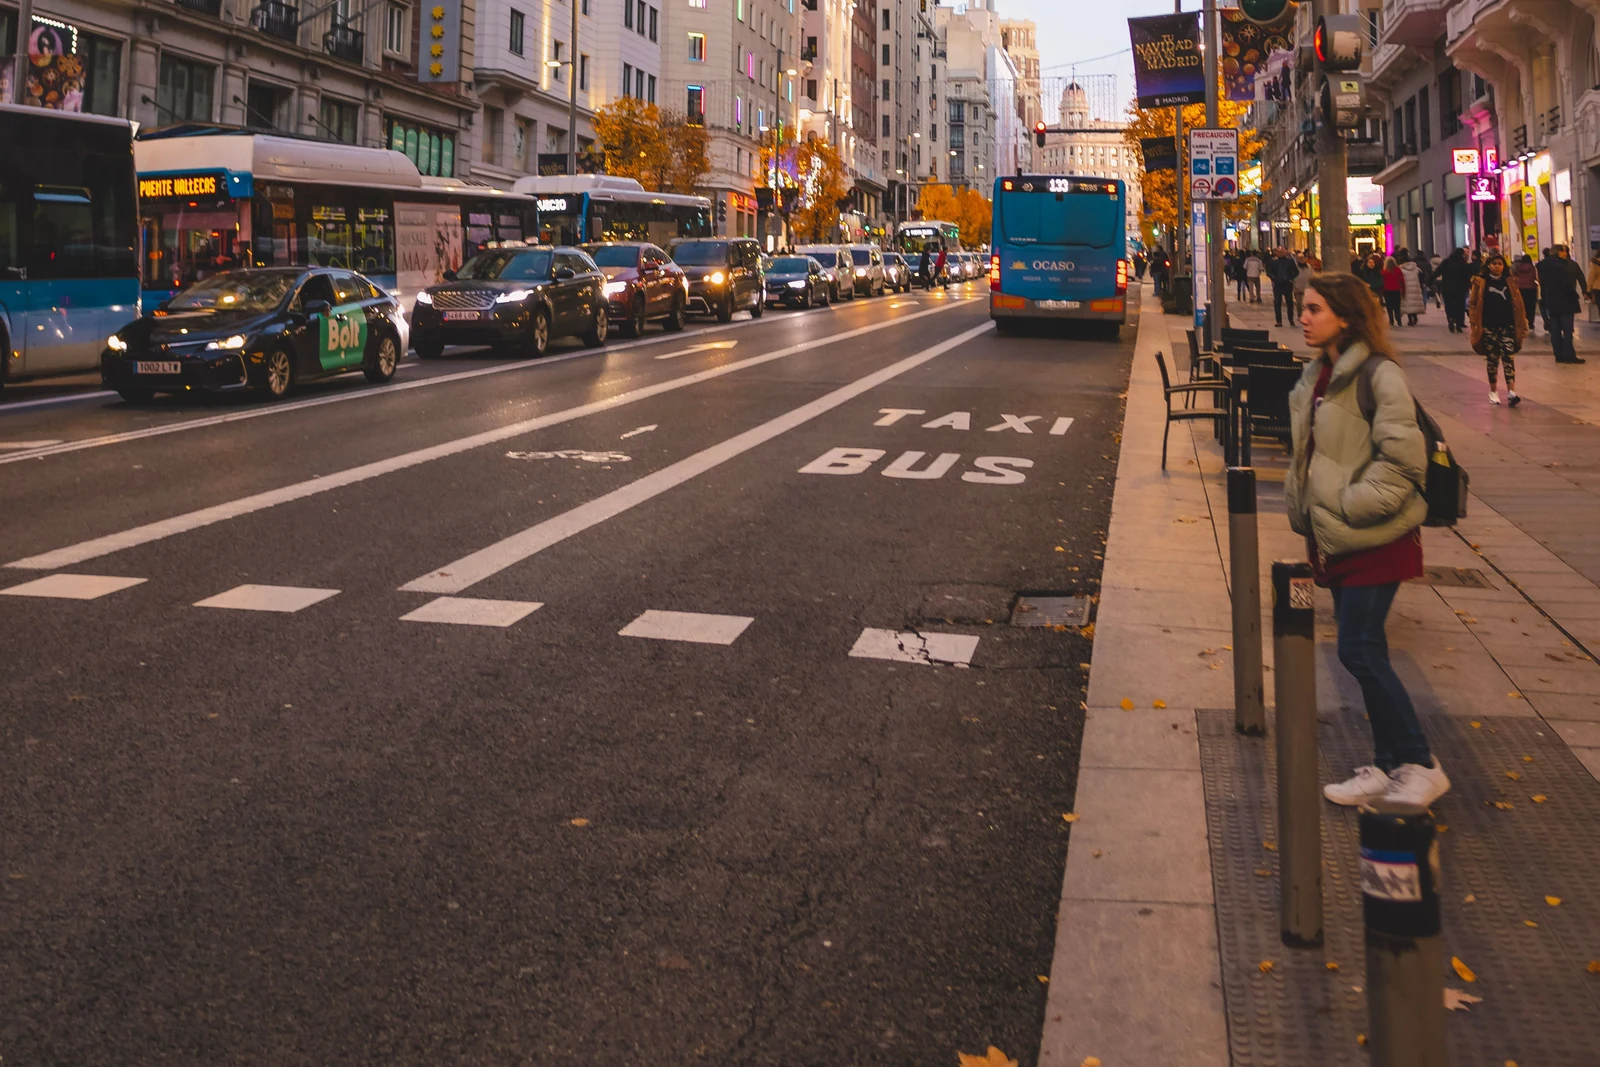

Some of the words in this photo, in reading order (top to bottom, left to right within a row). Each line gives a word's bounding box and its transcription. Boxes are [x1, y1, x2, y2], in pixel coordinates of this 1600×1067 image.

[1135, 38, 1193, 55] NAVIDAD
[1147, 55, 1199, 70] MADRID
[1162, 96, 1189, 104] MADRID
[139, 180, 173, 198] PUENTE
[1049, 179, 1069, 192] 133
[1032, 260, 1075, 271] OCASO
[328, 317, 360, 352] Bolt
[873, 408, 1075, 435] TAXI
[797, 447, 1034, 485] BUS
